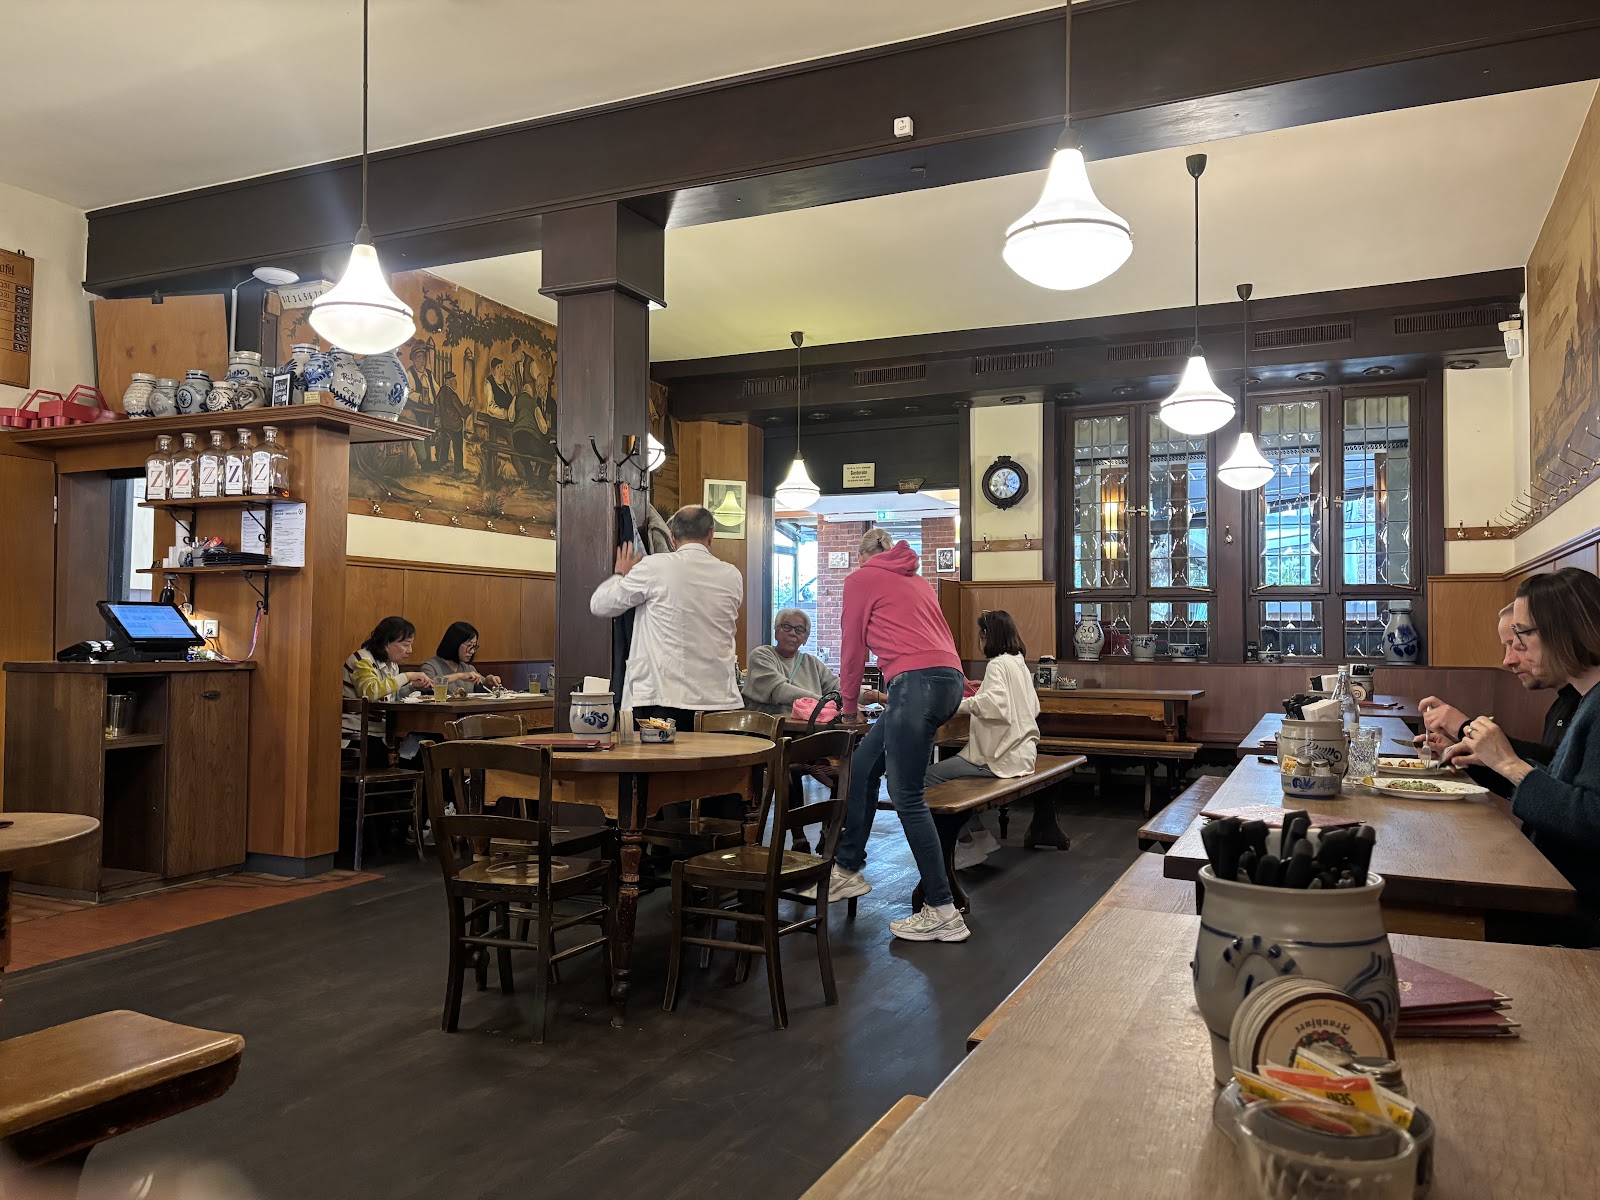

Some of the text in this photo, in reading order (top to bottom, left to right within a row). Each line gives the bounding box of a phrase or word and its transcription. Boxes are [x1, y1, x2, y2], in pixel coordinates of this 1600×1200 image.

[151, 470, 163, 488] Z
[175, 468, 189, 486] Z
[202, 466, 216, 484] Z
[229, 465, 240, 483] Z
[254, 463, 267, 481] Z
